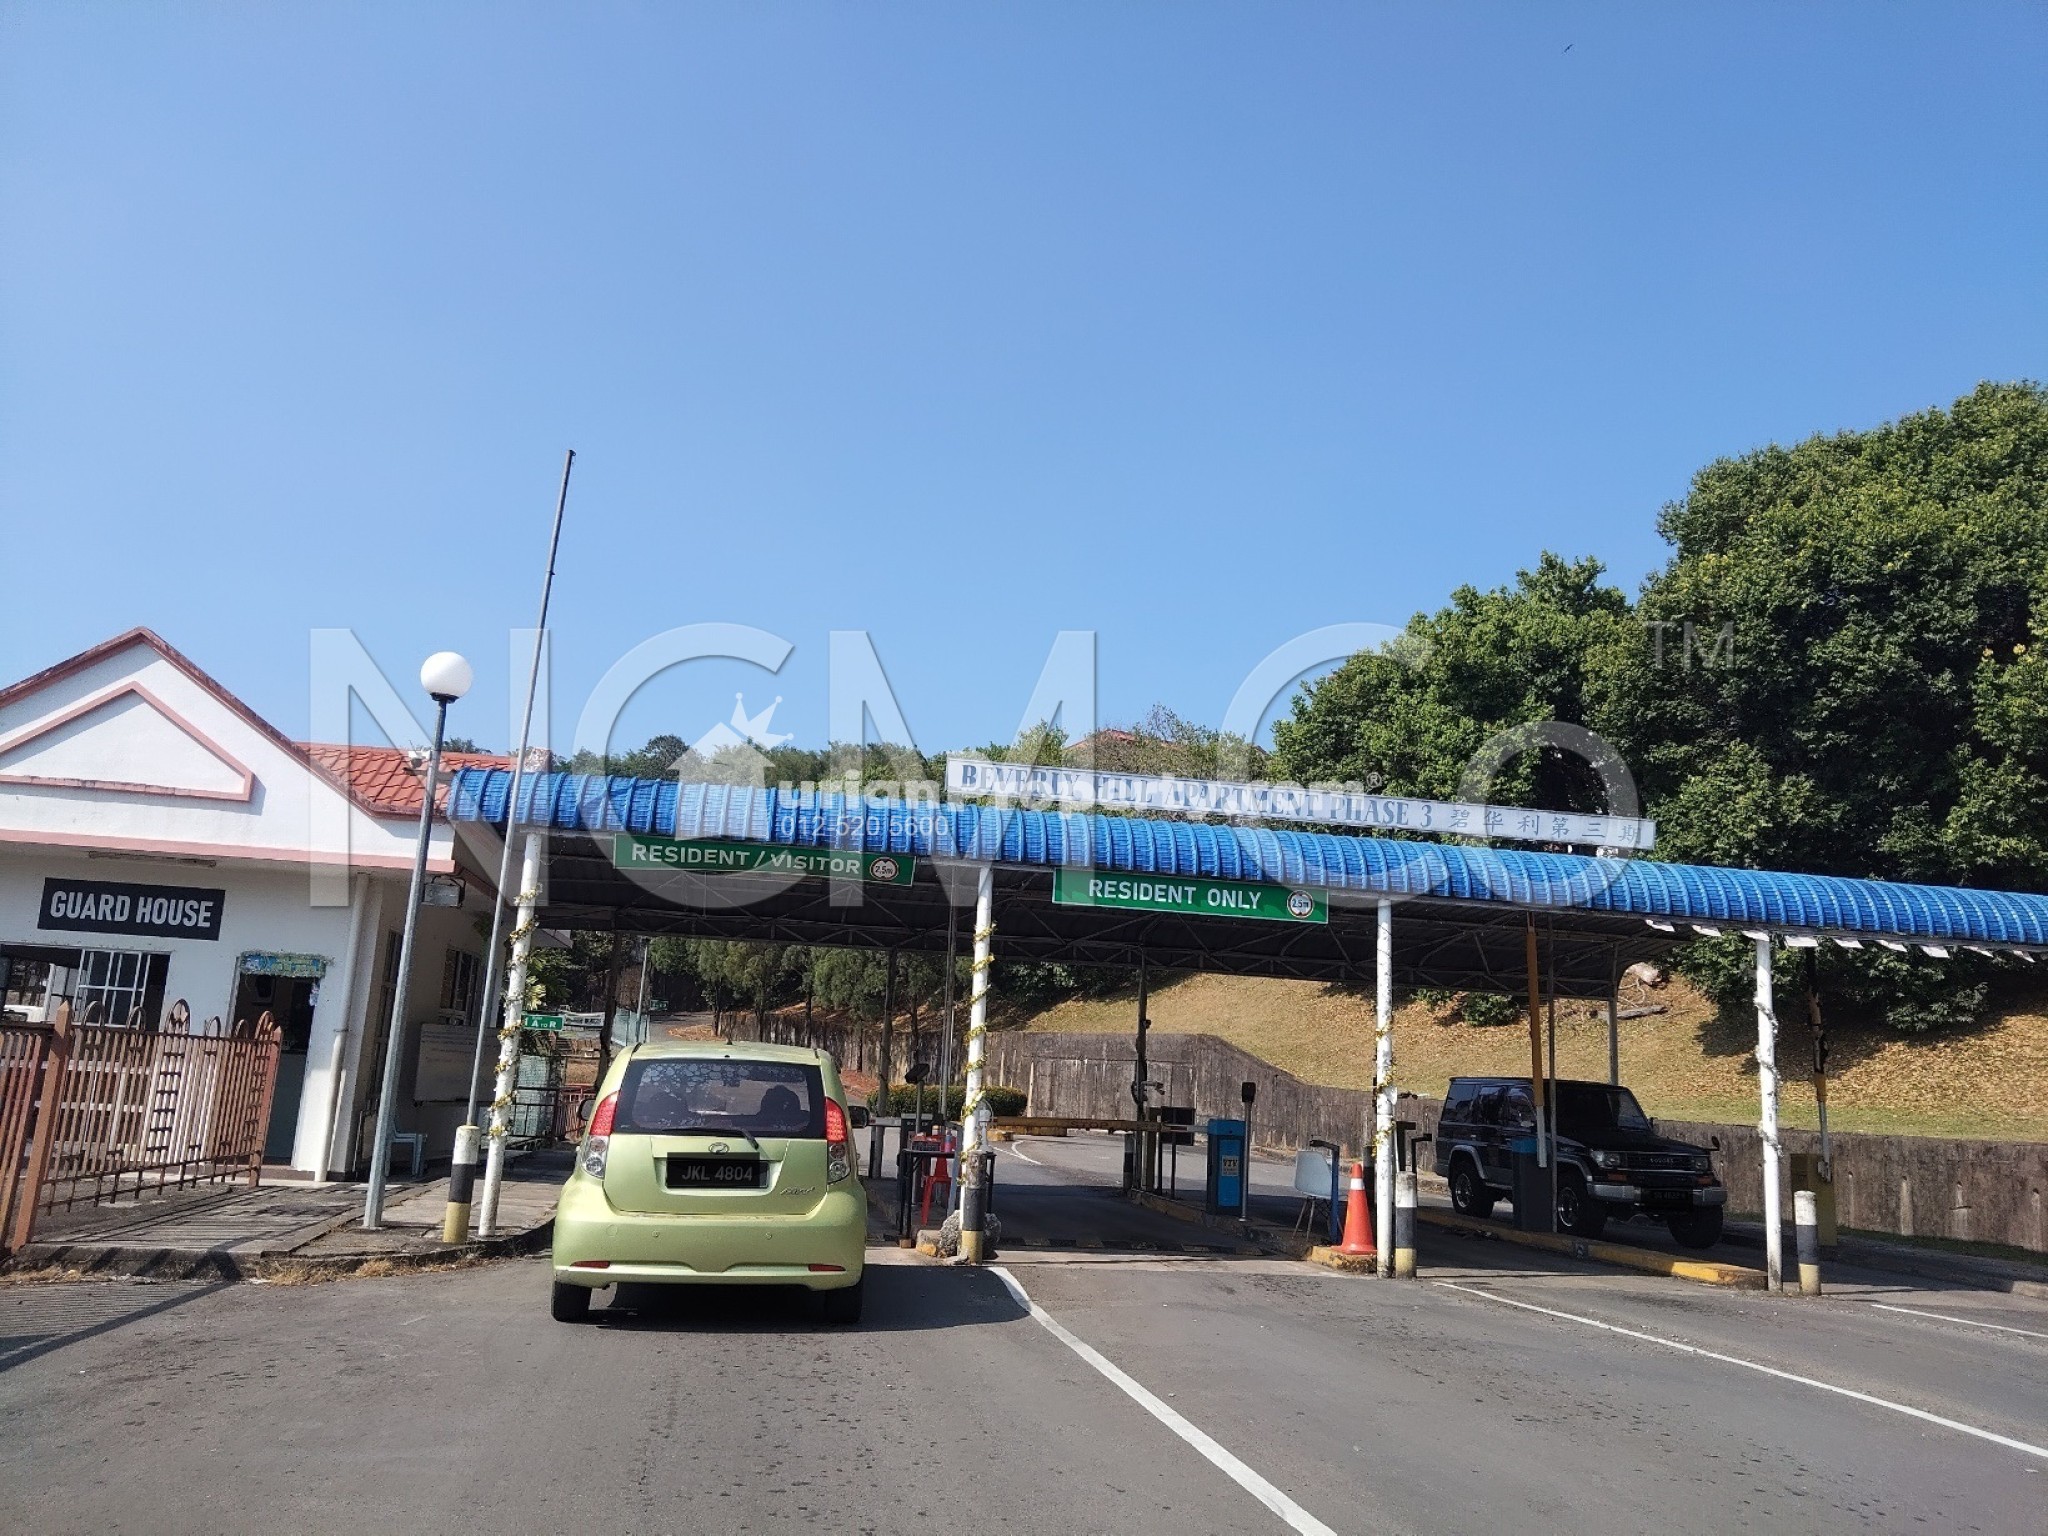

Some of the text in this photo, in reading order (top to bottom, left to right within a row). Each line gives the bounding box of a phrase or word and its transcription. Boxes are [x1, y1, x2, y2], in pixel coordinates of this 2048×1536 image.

[962, 764, 1433, 828] BEVERLY HILL APARTMENT PHASE 3
[631, 843, 750, 865] RESIDENT
[771, 852, 860, 874] VISITOR
[50, 890, 214, 928] GUARD HOUSE
[1088, 879, 1262, 909] RESIDENT ONLY
[681, 1165, 753, 1182] JKL 4804
